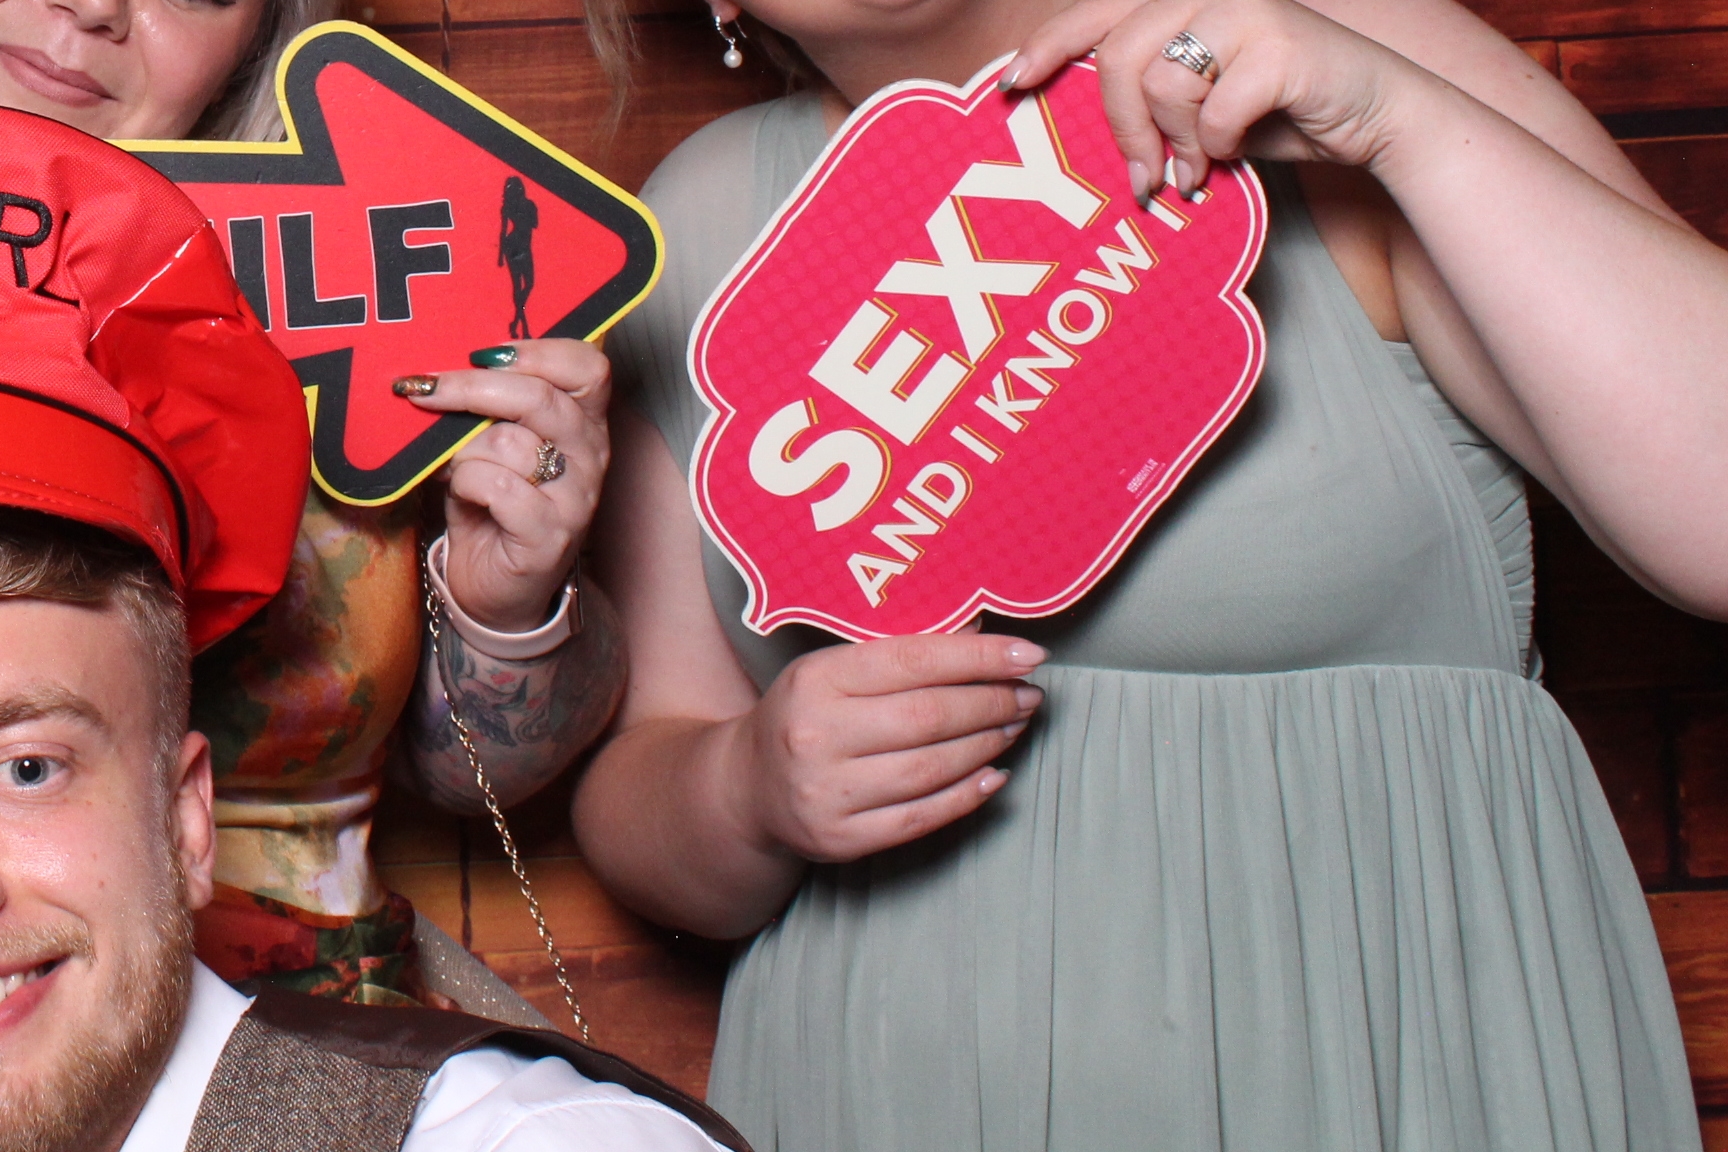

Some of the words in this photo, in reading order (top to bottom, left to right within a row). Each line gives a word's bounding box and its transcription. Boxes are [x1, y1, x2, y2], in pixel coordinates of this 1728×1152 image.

[207, 199, 454, 332] ILF
[749, 91, 1111, 532] SEXY
[974, 218, 1160, 434] KNOW
[950, 425, 1005, 464] I
[847, 461, 973, 608] AND
